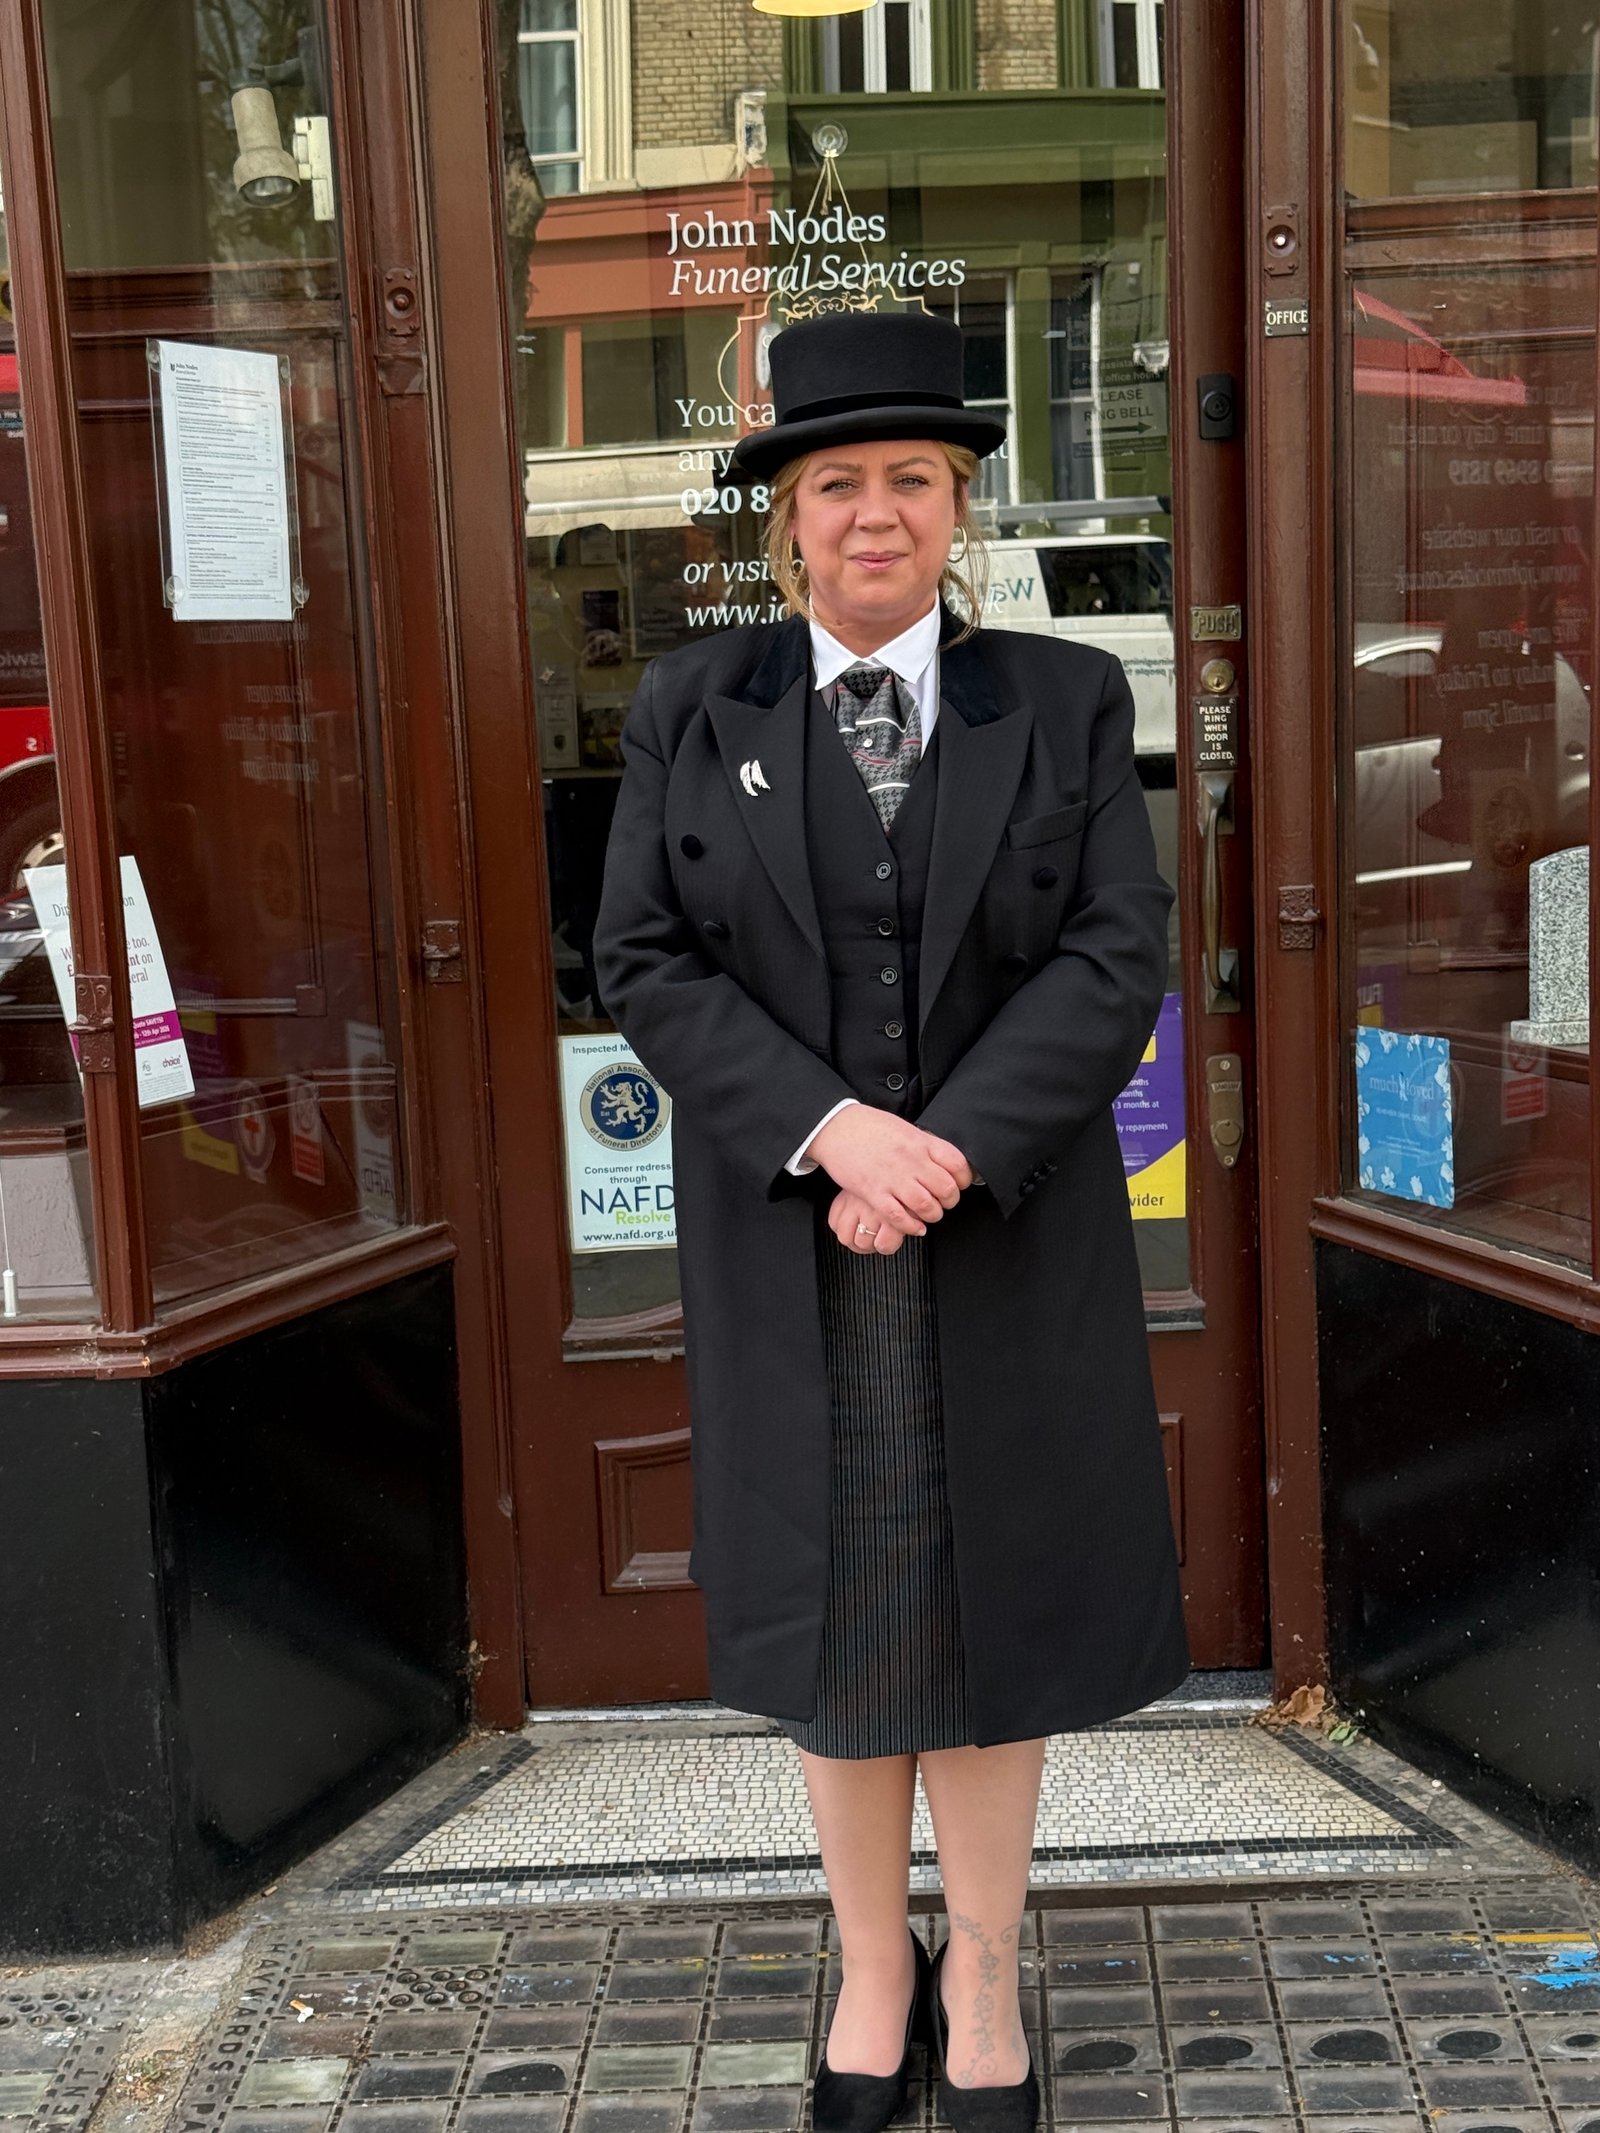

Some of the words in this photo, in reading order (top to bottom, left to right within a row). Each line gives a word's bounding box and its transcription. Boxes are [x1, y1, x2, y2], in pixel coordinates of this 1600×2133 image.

[667, 209, 757, 255] John
[766, 206, 886, 246] Nodes
[668, 254, 811, 296] Funeral
[817, 250, 966, 292] Services
[1266, 310, 1308, 325] OFFICE
[1100, 388, 1144, 402] LEASE
[674, 399, 737, 428] You
[744, 403, 776, 426] ca
[1083, 408, 1116, 422] RNG
[1119, 406, 1154, 419] BELL
[678, 449, 735, 478] any
[681, 486, 743, 516] 020
[683, 560, 715, 585] or
[1199, 614, 1236, 634] PUSH
[1199, 706, 1231, 715] PLEASE
[1204, 714, 1227, 723] RING
[1204, 724, 1228, 732] WHEN
[1204, 733, 1228, 742] DOOR
[1211, 743, 1222, 751] IS
[1200, 752, 1235, 761] CLOSED.
[132, 937, 150, 949] too.
[142, 952, 154, 965] on
[130, 967, 150, 984] eral
[572, 1044, 618, 1055] Inspected
[586, 1066, 615, 1094] National
[616, 1064, 661, 1091] Association
[1128, 1078, 1150, 1087] onths
[1369, 1075, 1399, 1093] much
[1123, 1100, 1151, 1109] months
[1151, 1101, 1160, 1109] at
[1125, 1123, 1169, 1133] repayments
[597, 1133, 629, 1149] Funeral
[630, 1122, 664, 1149] Directors
[584, 1165, 633, 1175] Consumer
[636, 1163, 672, 1173] redress
[609, 1174, 648, 1185] through
[580, 1184, 674, 1216] NAFD
[1129, 1193, 1165, 1207] vider
[616, 1209, 672, 1225] Resolve
